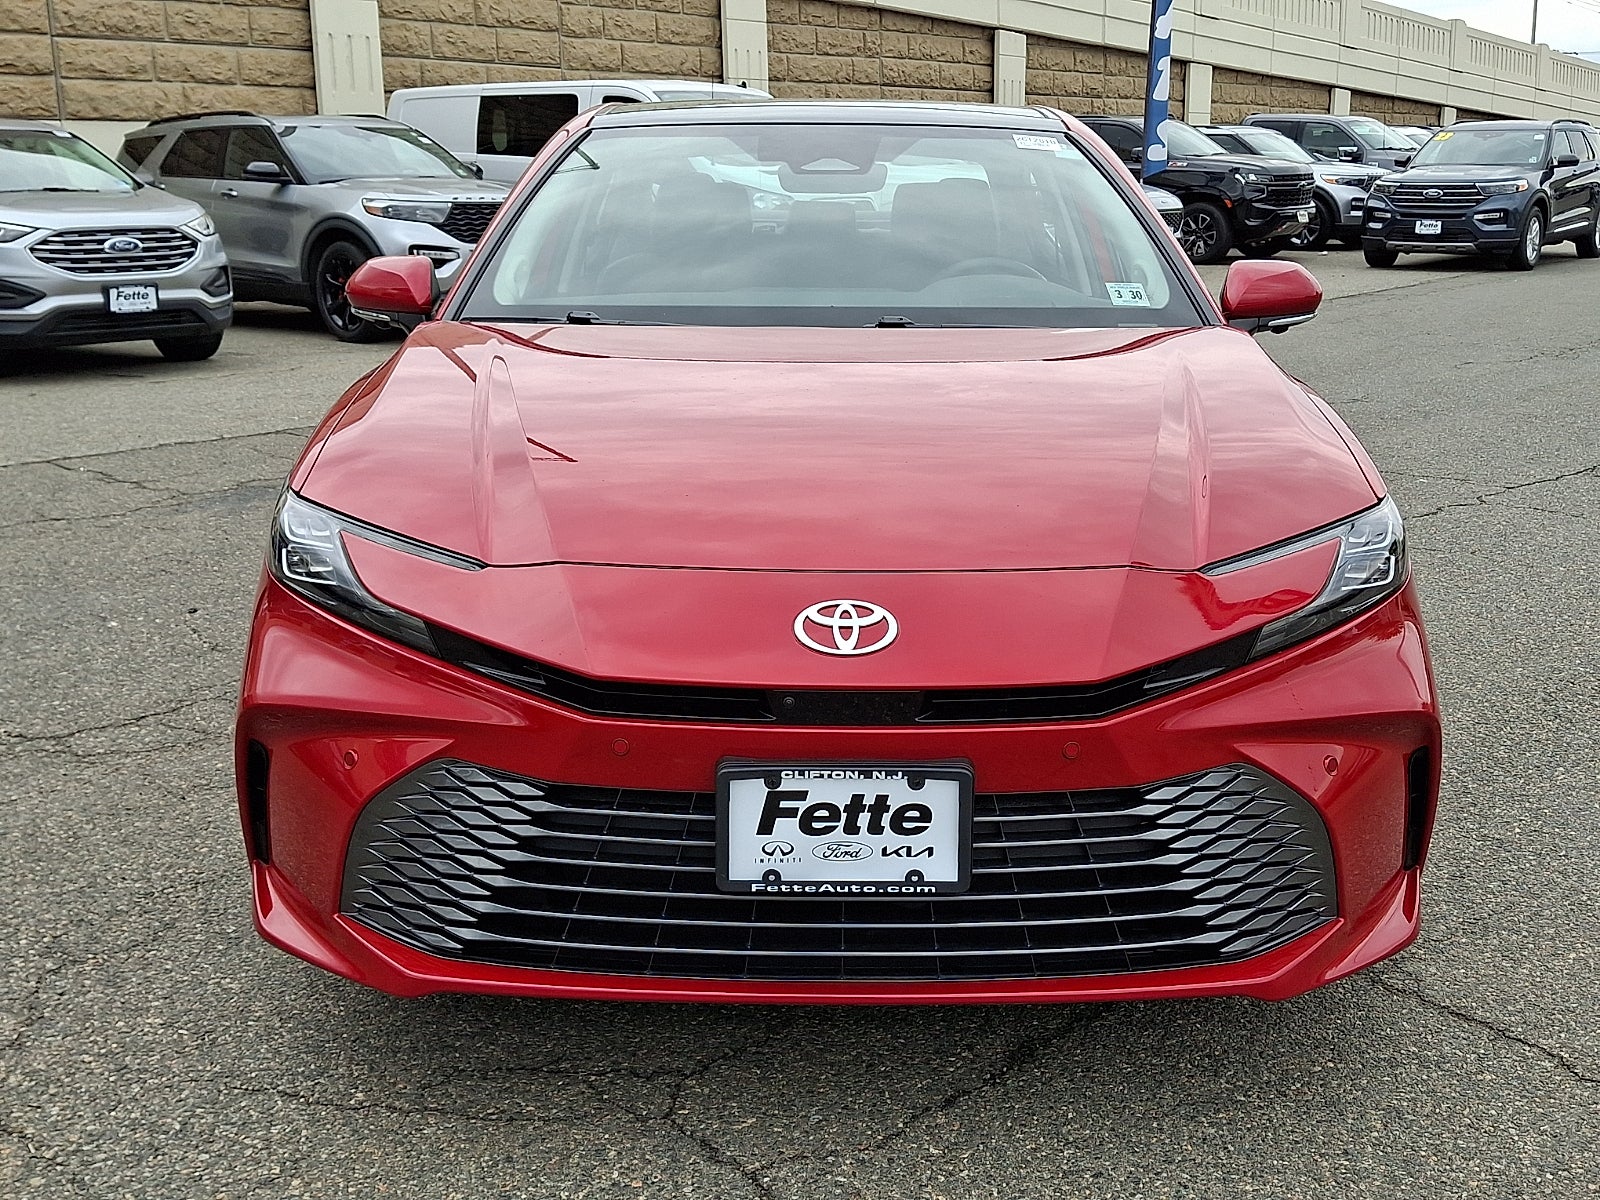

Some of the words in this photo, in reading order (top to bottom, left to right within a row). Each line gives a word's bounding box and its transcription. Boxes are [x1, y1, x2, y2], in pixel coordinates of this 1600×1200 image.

[116, 290, 149, 301] Fette
[1114, 289, 1123, 299] 3
[1128, 290, 1143, 300] 30
[780, 770, 865, 781] CLIFTON,
[872, 771, 908, 780] N.J.
[755, 789, 933, 837] Fette
[751, 883, 937, 894] FetteAuto.com
